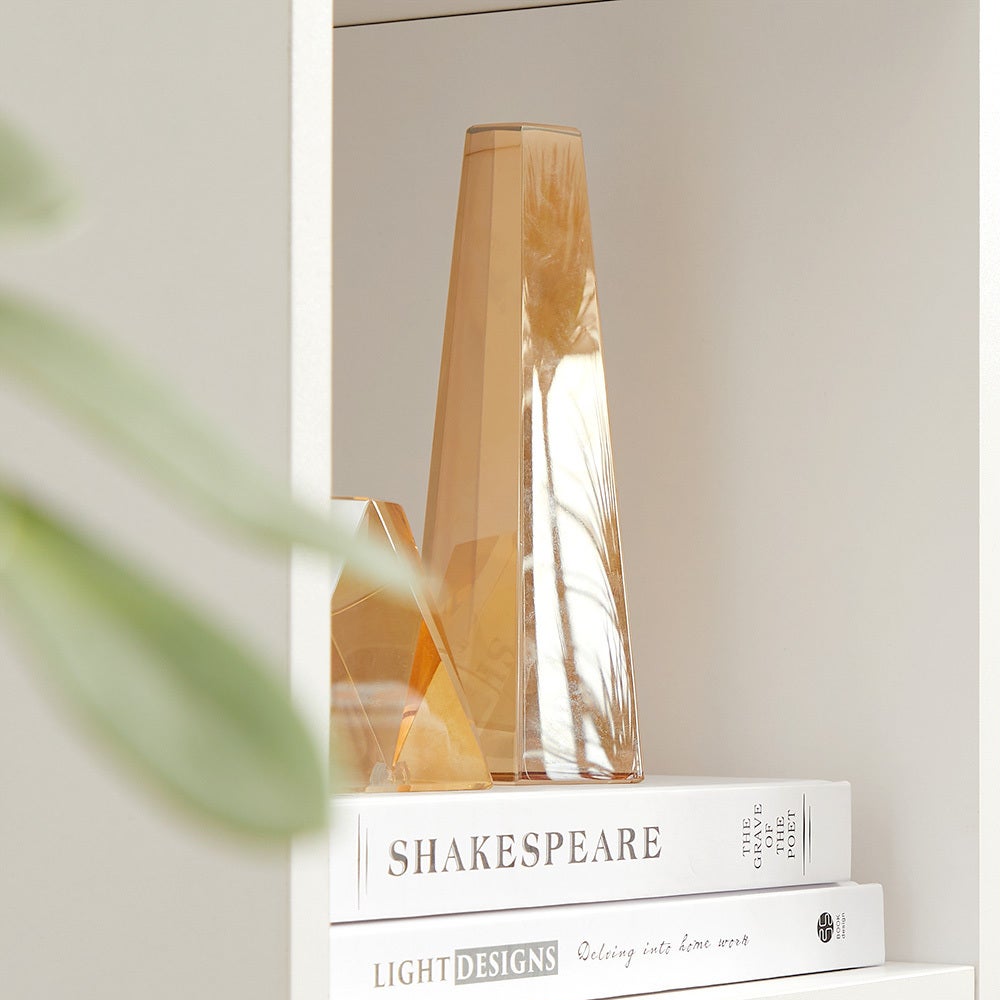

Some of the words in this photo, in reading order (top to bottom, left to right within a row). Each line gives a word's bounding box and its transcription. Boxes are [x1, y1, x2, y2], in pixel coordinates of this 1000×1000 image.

[386, 826, 663, 877] SHAKESPEARE
[742, 817, 751, 857] THE
[753, 803, 763, 869] GRAVE
[765, 823, 773, 848] OF
[776, 816, 785, 856] THE
[787, 809, 796, 859] POET
[373, 955, 451, 988] LIGHT
[455, 942, 558, 983] DESIGNS
[643, 940, 672, 956] into
[678, 933, 711, 952] home
